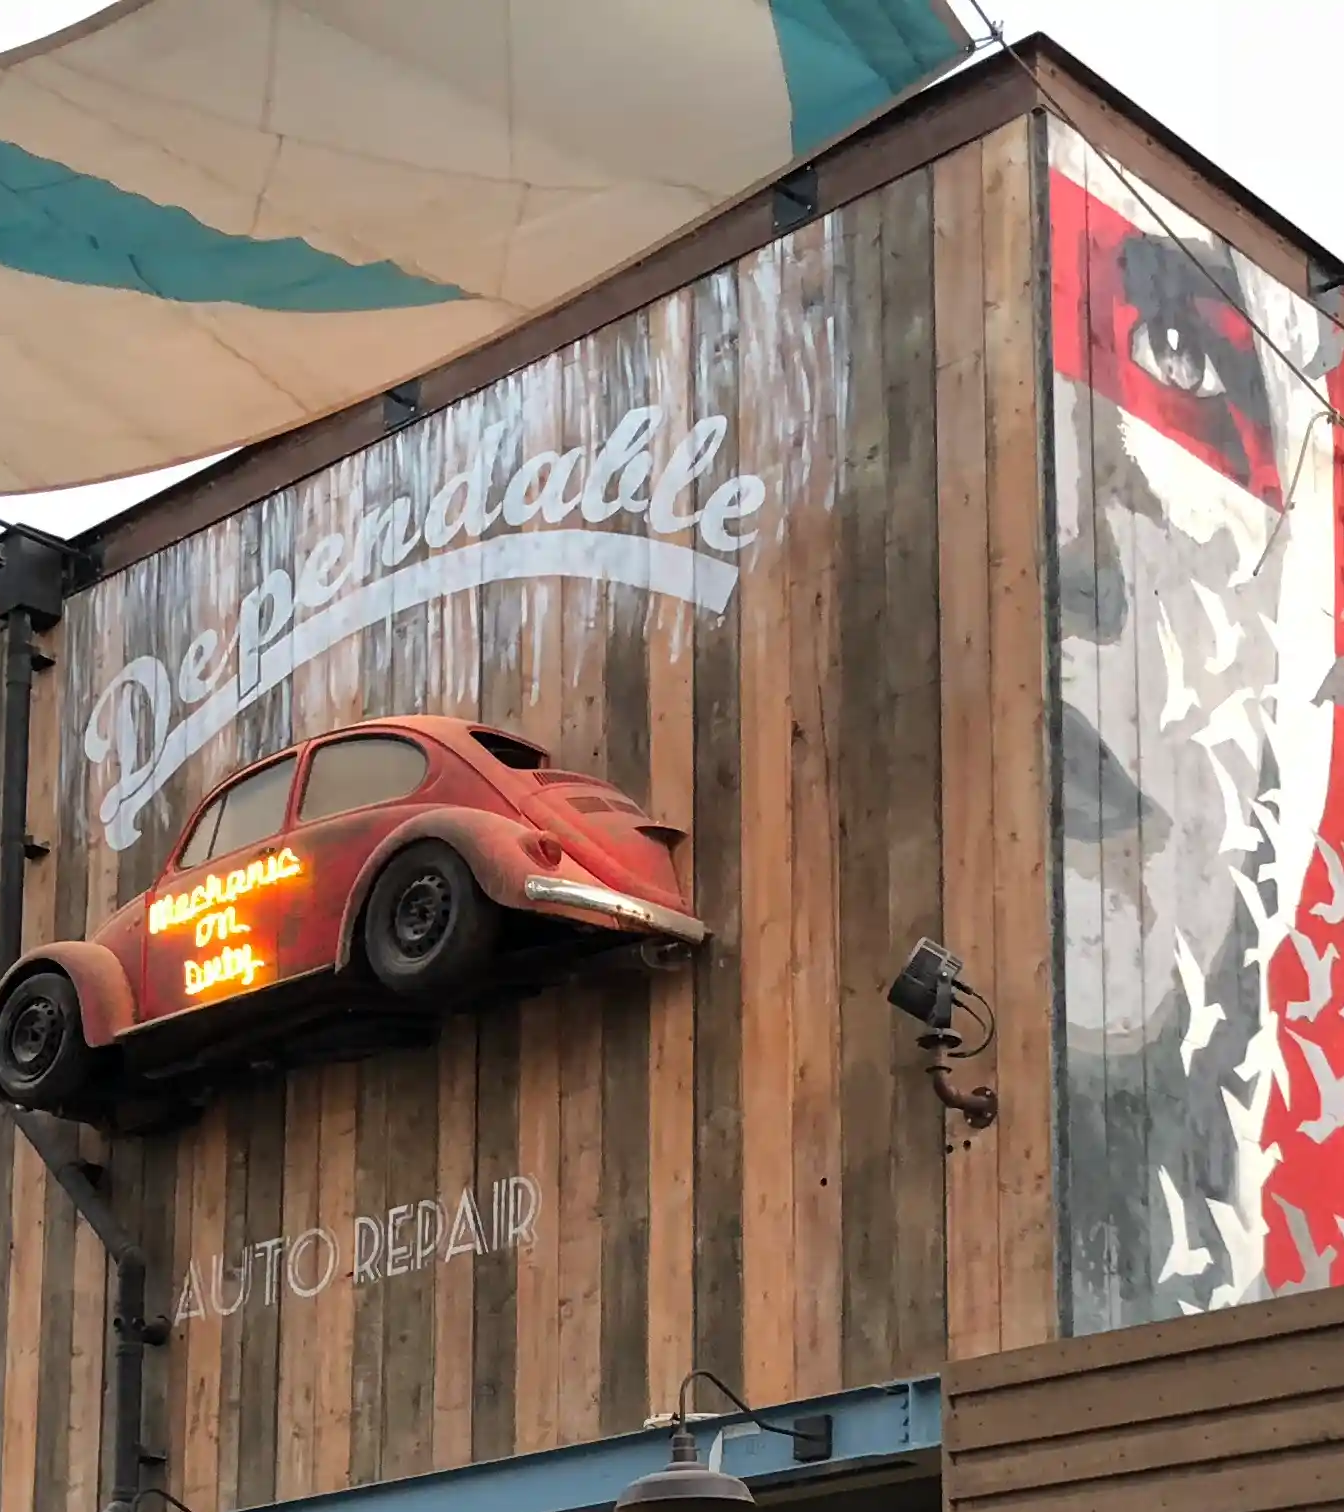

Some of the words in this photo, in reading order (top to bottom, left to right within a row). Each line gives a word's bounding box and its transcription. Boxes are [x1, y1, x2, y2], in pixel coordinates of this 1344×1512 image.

[85, 404, 767, 850] Dependable
[148, 847, 301, 935] Mechanic
[173, 1227, 340, 1328] AUTO
[352, 1172, 543, 1285] REPAIR
